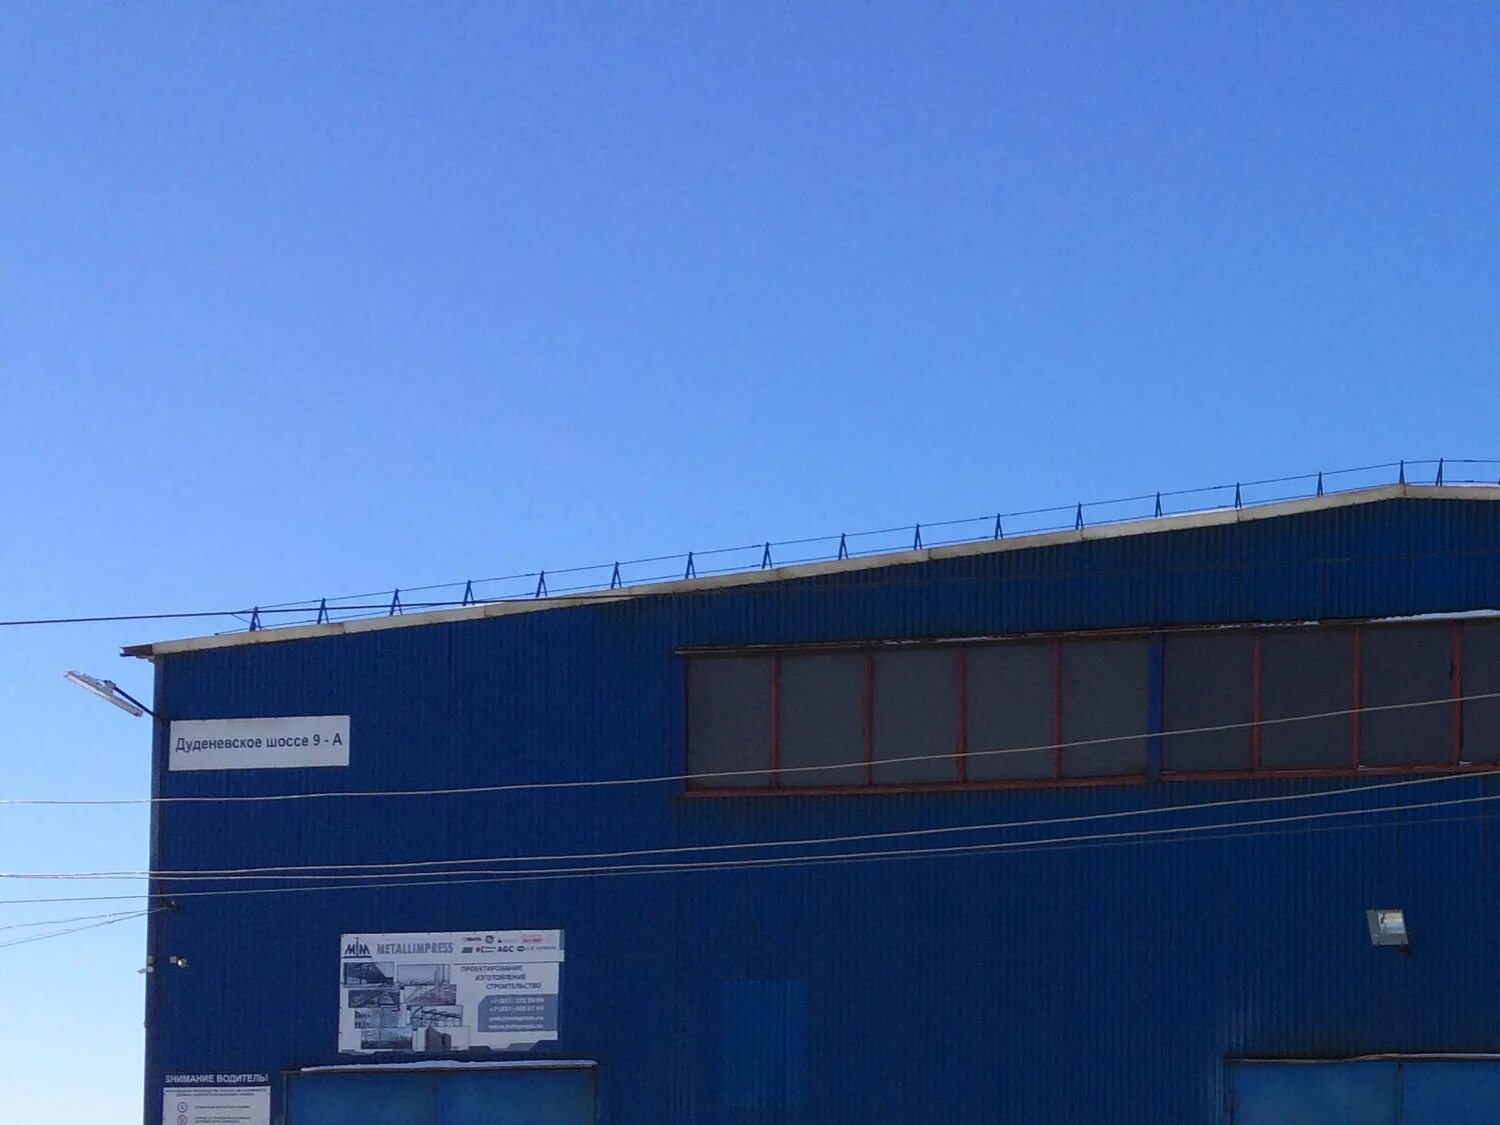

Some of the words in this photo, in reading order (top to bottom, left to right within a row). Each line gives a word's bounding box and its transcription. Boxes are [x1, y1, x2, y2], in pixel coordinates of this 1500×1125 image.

[175, 737, 262, 753] Дуденевское
[266, 736, 308, 748] шоссе
[312, 734, 320, 746] 9
[332, 733, 343, 746] А
[376, 942, 454, 955] METALLIMPRESS
[165, 1074, 214, 1083] ВНИМАНИЕ
